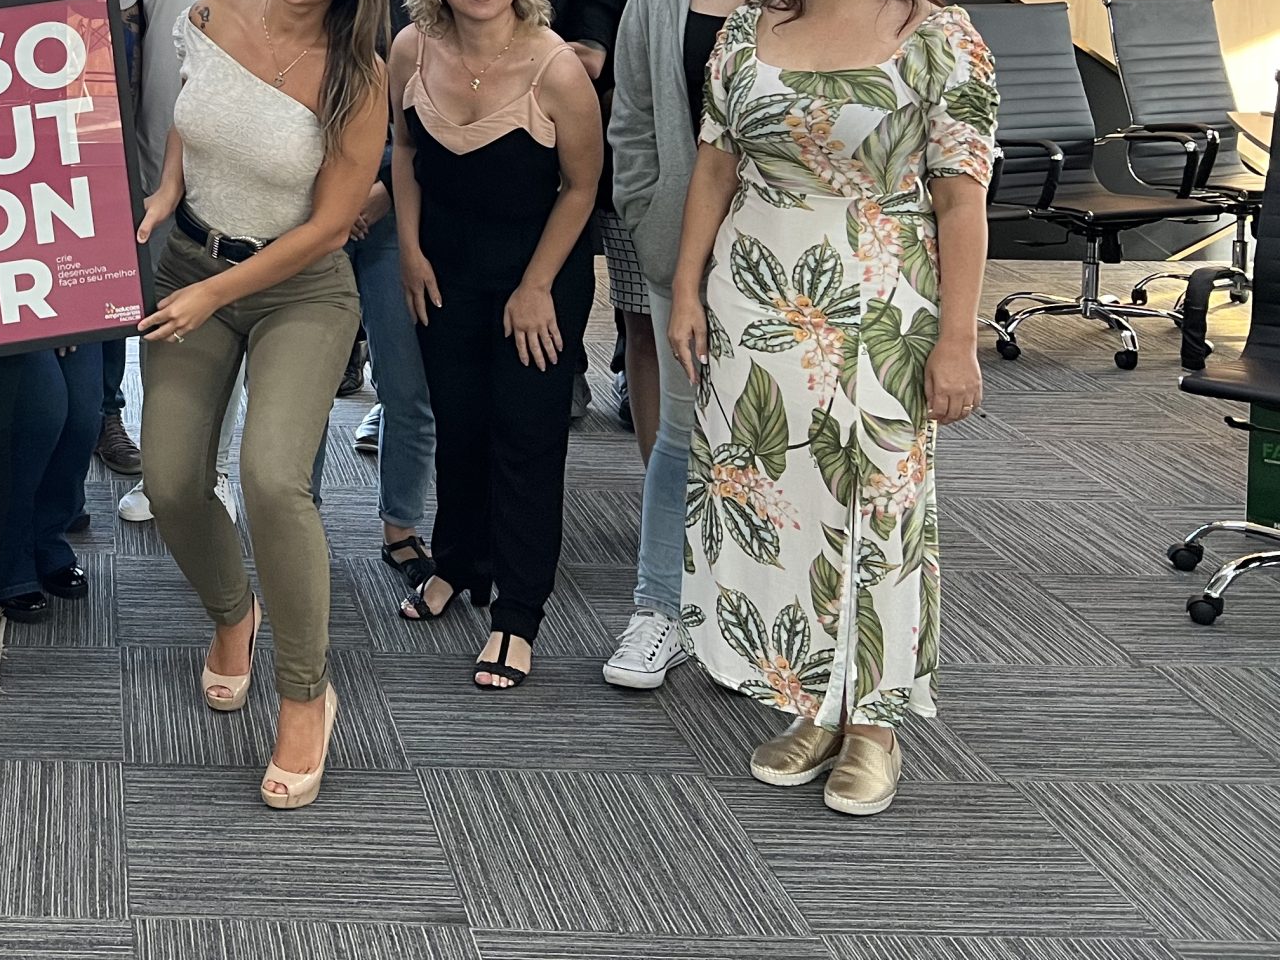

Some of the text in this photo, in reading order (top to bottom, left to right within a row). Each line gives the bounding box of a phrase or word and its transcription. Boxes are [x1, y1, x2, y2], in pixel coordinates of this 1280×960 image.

[56, 254, 73, 264] crie
[57, 262, 81, 271] inove
[57, 265, 107, 279] desenvolva
[58, 276, 78, 288] faça
[86, 274, 103, 283] seu
[104, 269, 137, 280] melhor
